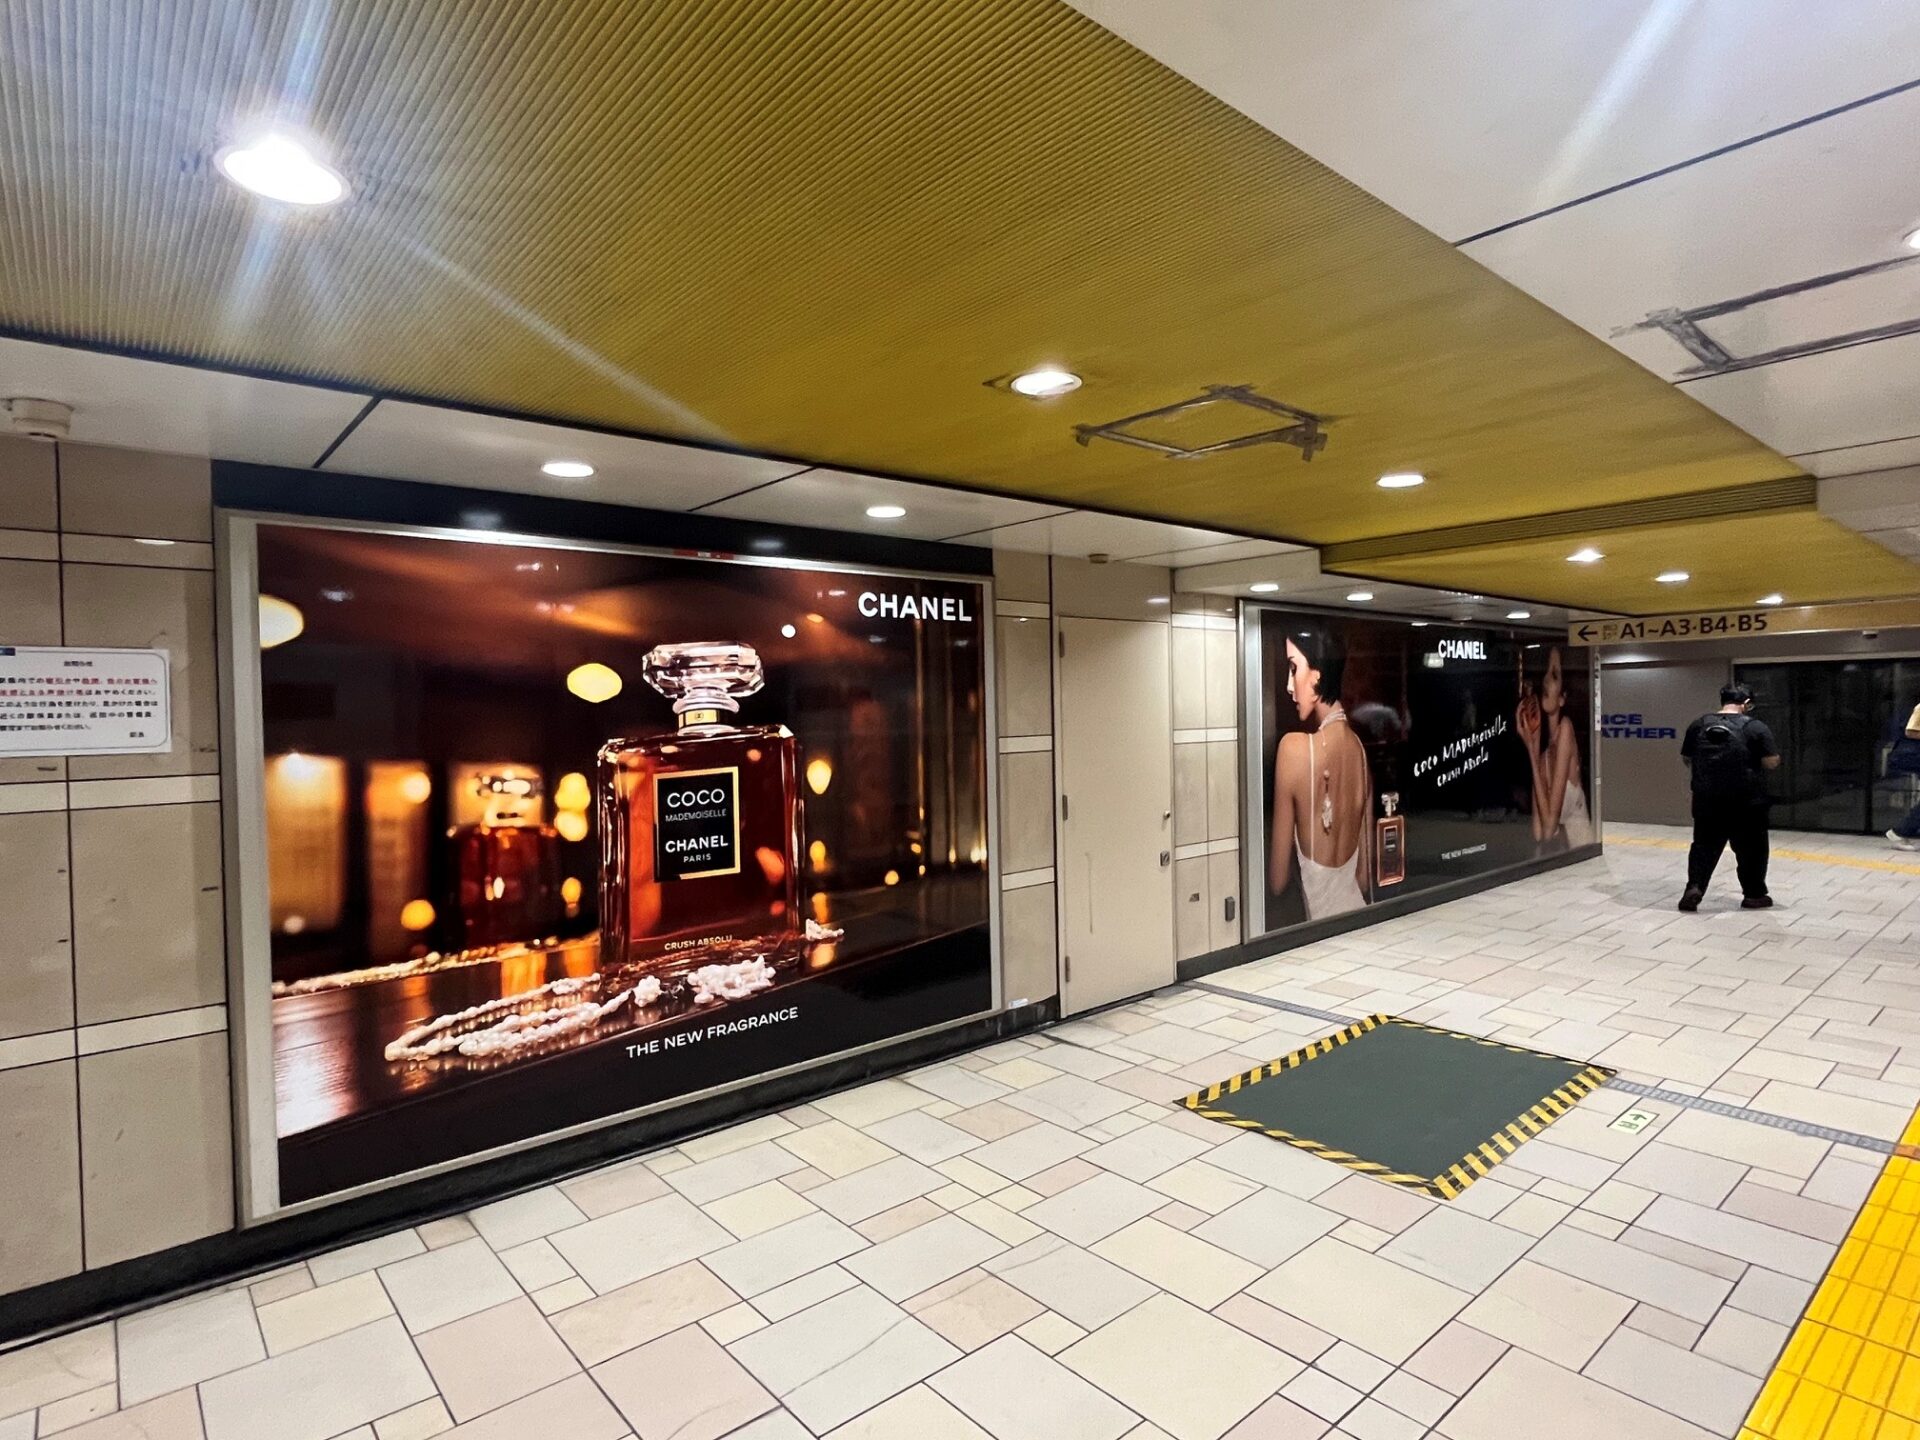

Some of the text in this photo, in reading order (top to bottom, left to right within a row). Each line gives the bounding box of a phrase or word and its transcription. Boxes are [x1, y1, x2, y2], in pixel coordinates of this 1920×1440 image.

[858, 592, 972, 621] CHANEL
[1438, 639, 1487, 660] CHANEL
[667, 788, 725, 808] COCO
[665, 808, 727, 822] MADEMOISELLE
[665, 835, 729, 853] CHANEL
[683, 853, 712, 863] PARIS
[664, 934, 733, 951] CRUSH ABSOLU
[625, 1006, 799, 1058] THE NEW FRAGRANCE
